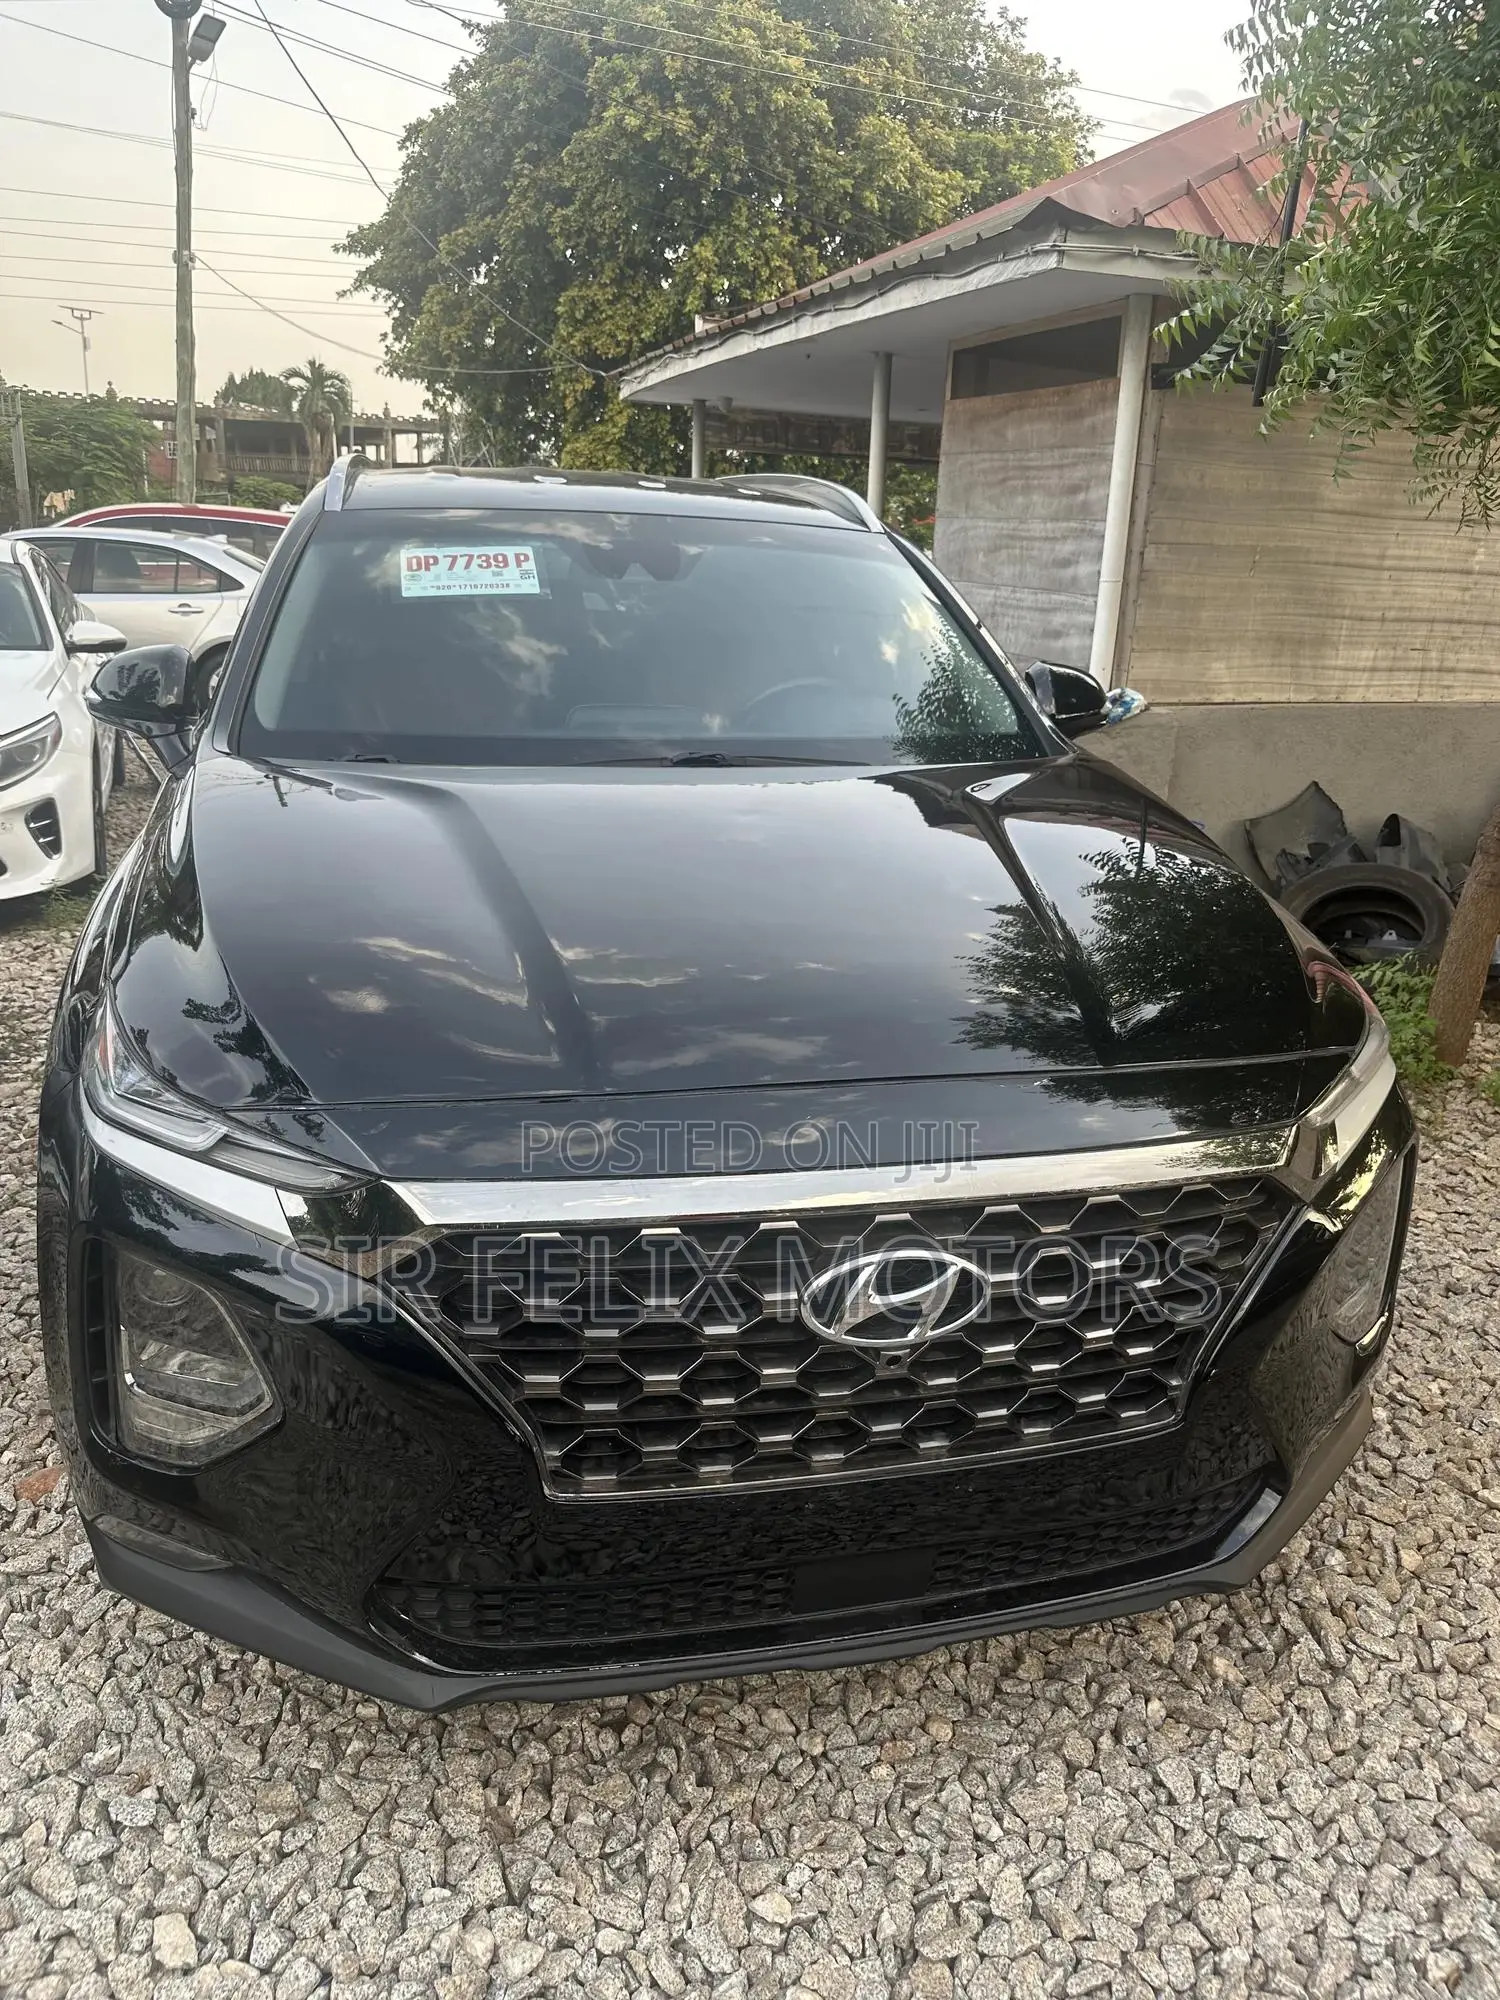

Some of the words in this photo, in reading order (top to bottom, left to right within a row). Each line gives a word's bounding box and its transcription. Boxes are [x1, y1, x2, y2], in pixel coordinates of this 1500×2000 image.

[406, 555, 439, 573] DP
[443, 553, 510, 571] 7739
[514, 552, 530, 569] P
